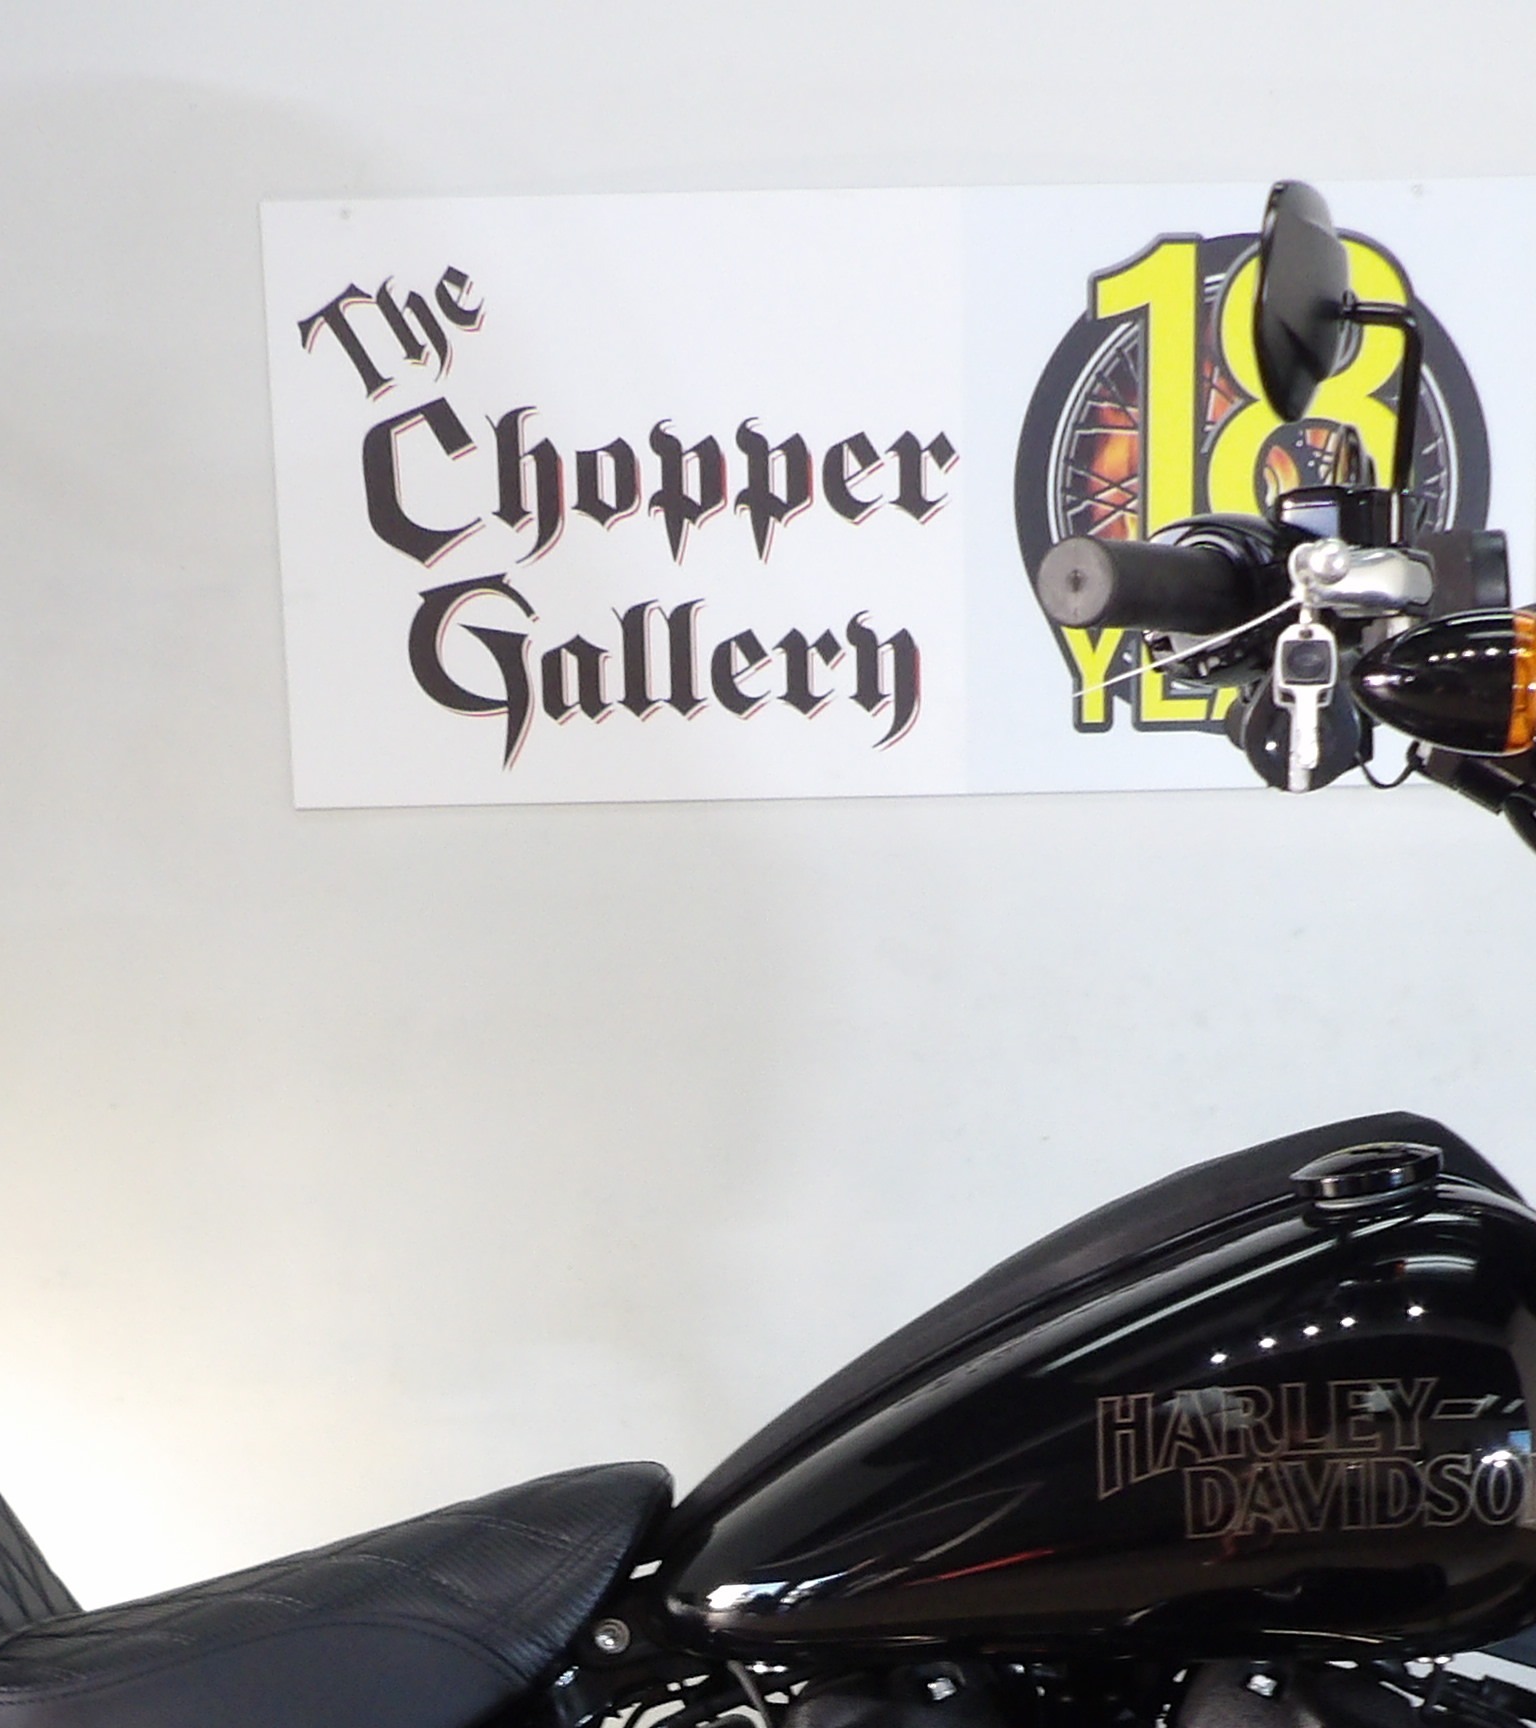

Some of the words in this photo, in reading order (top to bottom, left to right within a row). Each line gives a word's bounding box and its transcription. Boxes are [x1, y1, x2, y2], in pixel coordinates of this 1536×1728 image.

[297, 264, 486, 400] The
[360, 396, 961, 567] Chopper
[408, 572, 921, 771] Gallery
